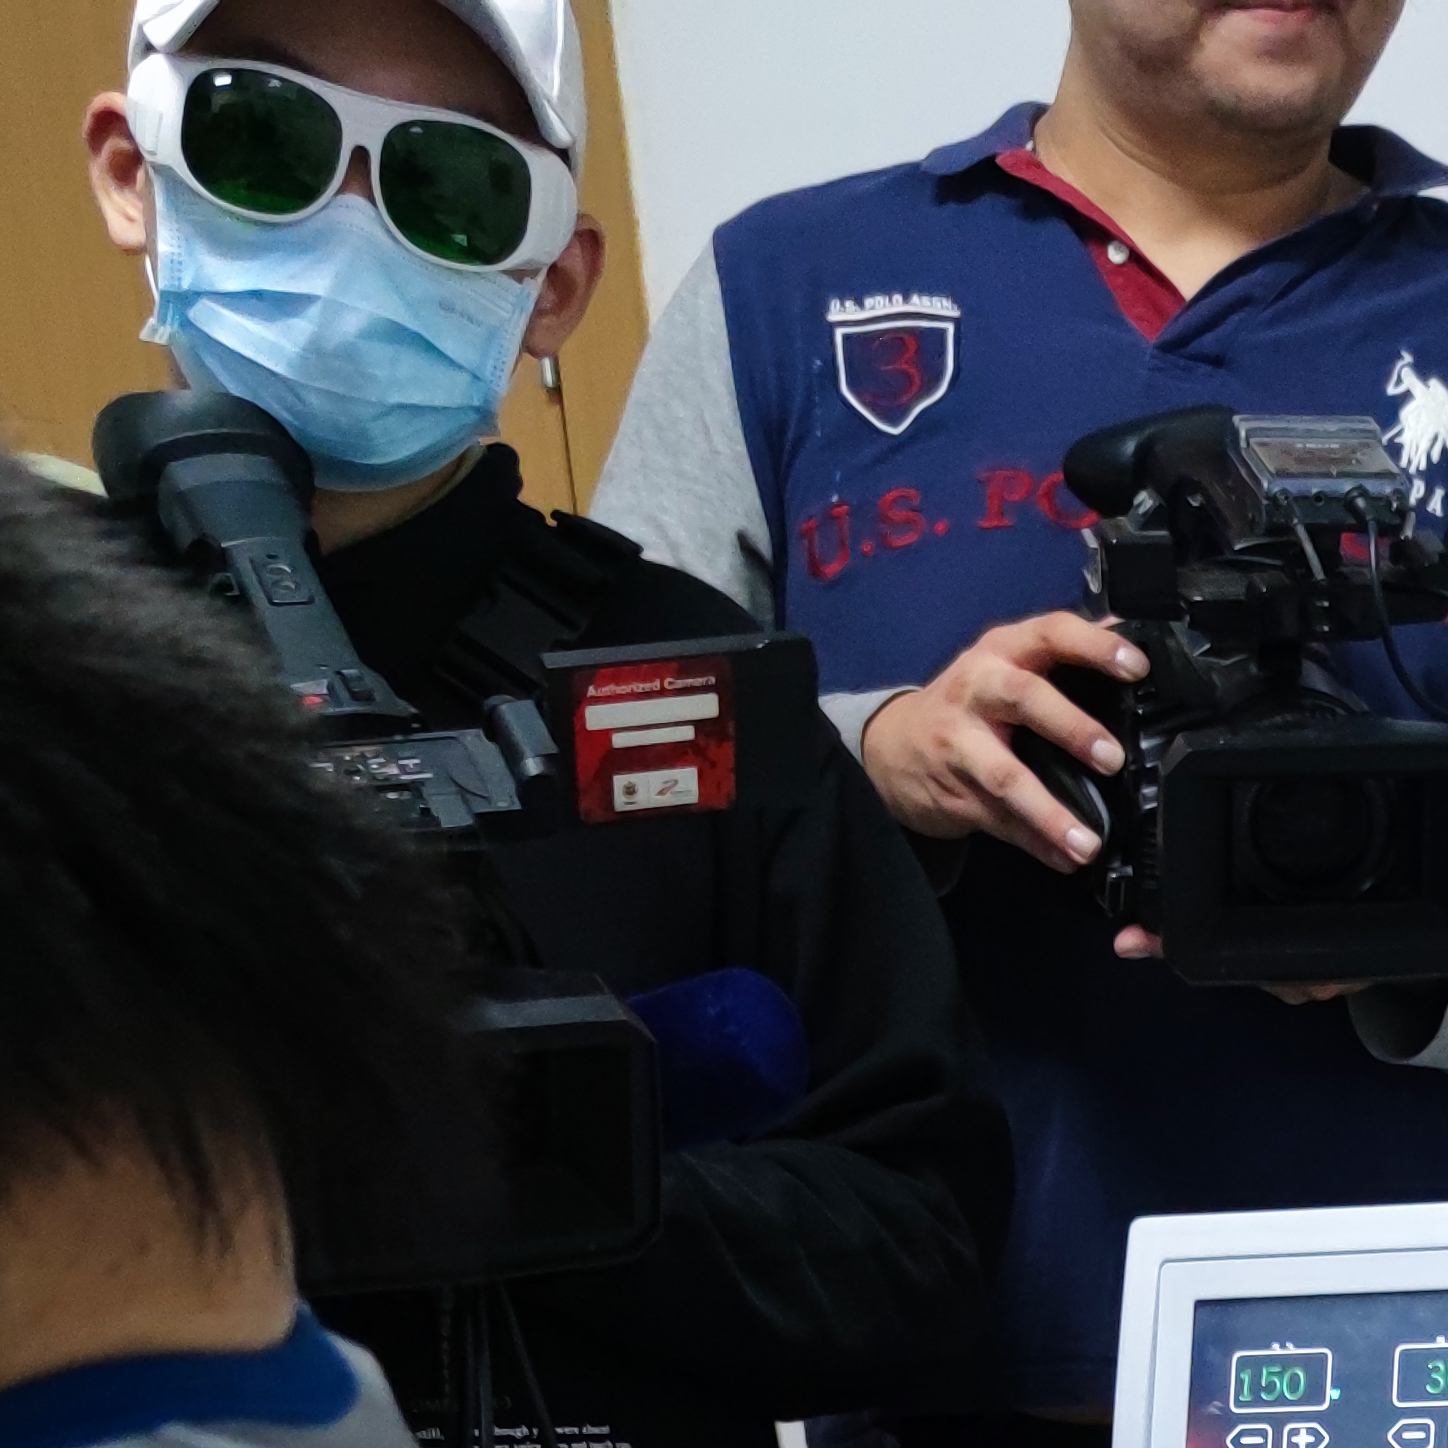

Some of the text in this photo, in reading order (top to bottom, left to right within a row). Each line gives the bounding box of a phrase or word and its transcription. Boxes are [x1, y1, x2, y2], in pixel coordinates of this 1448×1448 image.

[868, 331, 922, 408] 3
[799, 486, 951, 581] U.S.
[586, 675, 716, 698] Authorized Camera
[1238, 1365, 1306, 1401] 150
